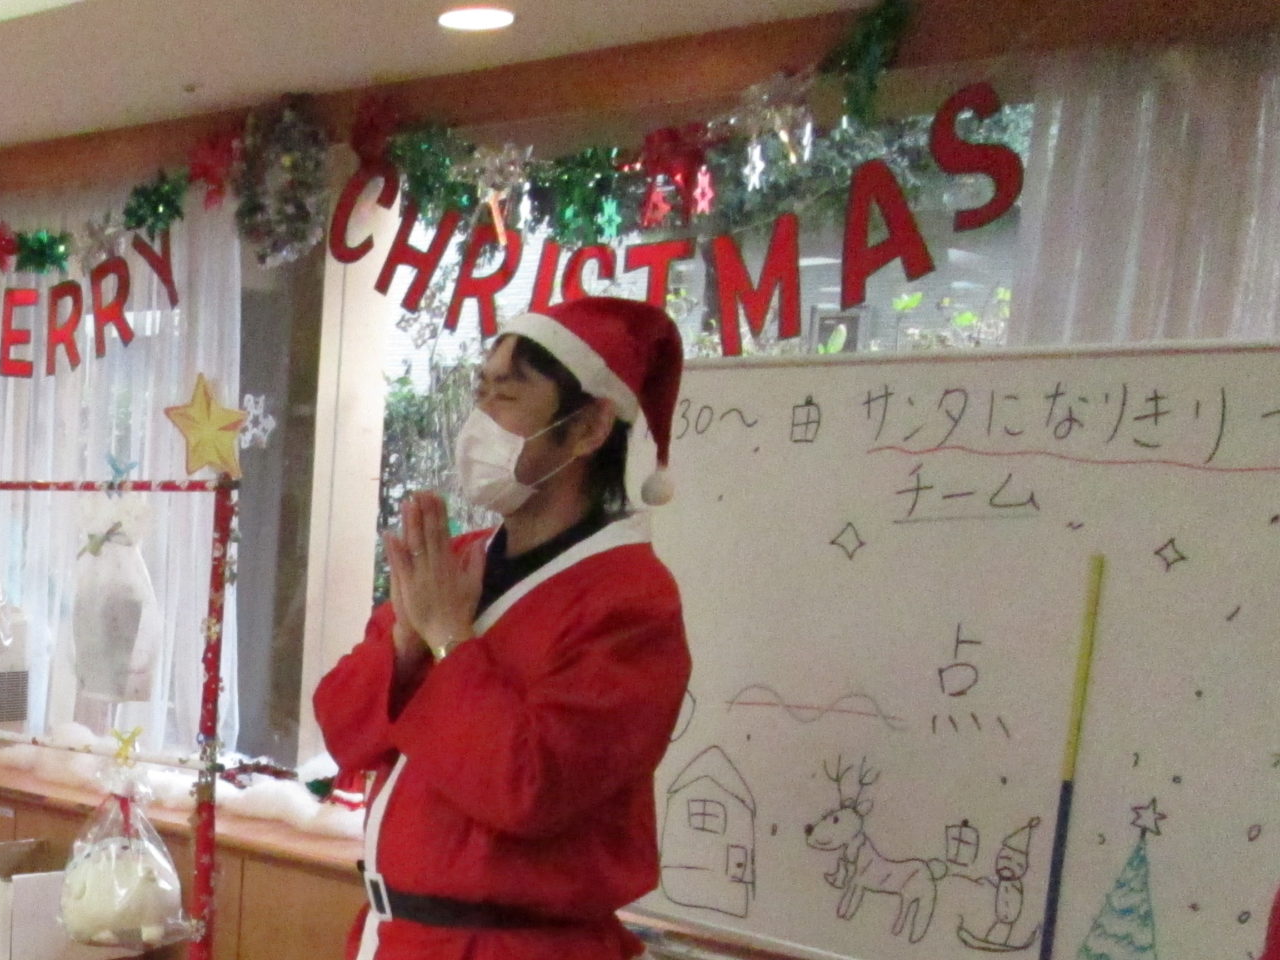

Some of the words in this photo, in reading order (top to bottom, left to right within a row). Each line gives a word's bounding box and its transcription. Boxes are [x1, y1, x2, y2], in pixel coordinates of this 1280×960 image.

[862, 382, 1280, 464] サンタになりきり
[895, 463, 1040, 517] チーム
